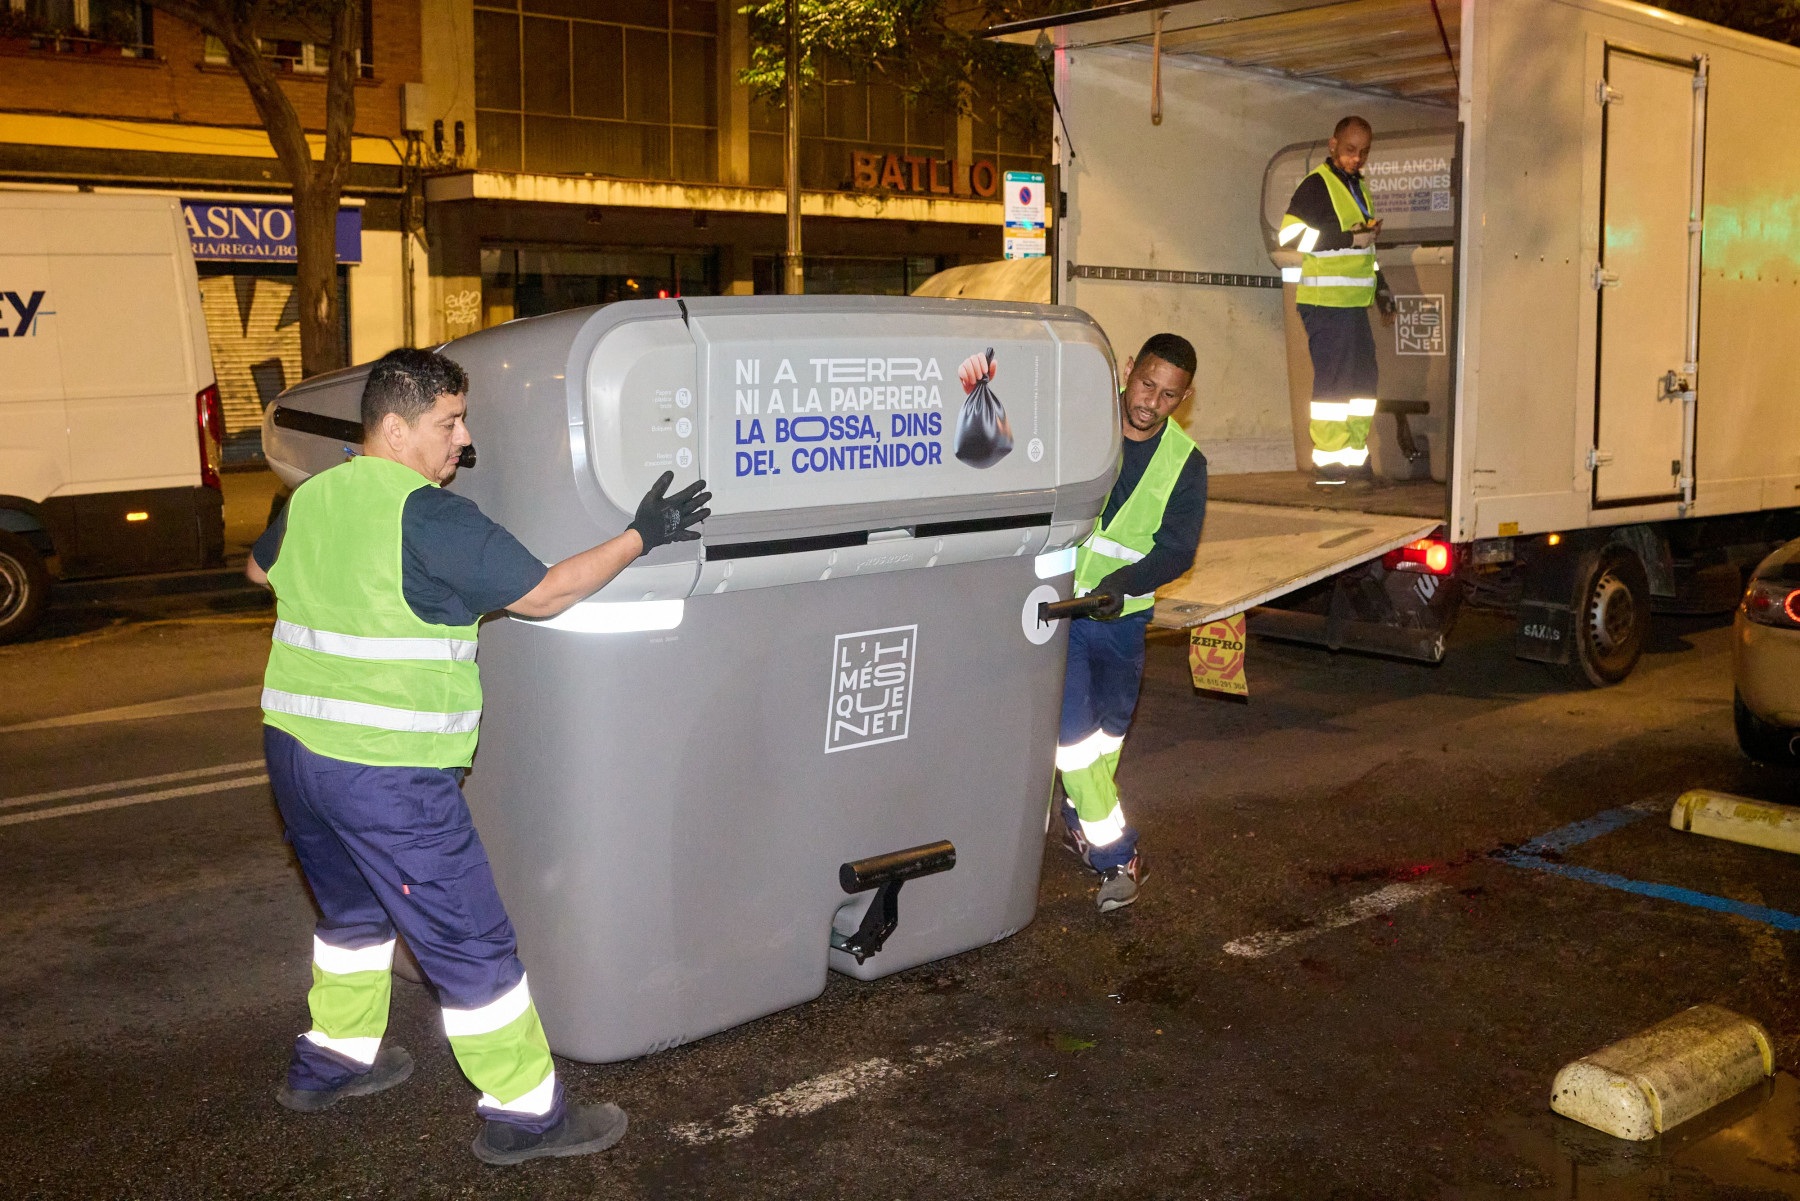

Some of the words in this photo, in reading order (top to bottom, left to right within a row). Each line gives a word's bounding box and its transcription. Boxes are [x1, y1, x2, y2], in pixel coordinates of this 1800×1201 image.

[1369, 173, 1451, 192] SANCIONES
[184, 205, 295, 240] ASNO
[1400, 325, 1441, 339] QUE
[1400, 338, 1442, 350] NET
[736, 359, 760, 385] NI
[773, 358, 798, 384] A
[809, 357, 943, 383] TERRA
[736, 389, 760, 415] NI
[766, 388, 786, 414] A
[792, 387, 823, 413] LA
[830, 385, 943, 412] PAPERERA
[735, 418, 766, 445] LA
[775, 414, 882, 443] BOSSA,
[891, 411, 943, 438] DINS
[735, 449, 781, 477] DEL
[791, 441, 943, 474] CONTENIDOR
[841, 637, 908, 668] L'H
[1191, 635, 1243, 651] ZEPRO
[838, 660, 907, 693] MÉS
[836, 686, 905, 719] QUE
[834, 709, 904, 742] NET
